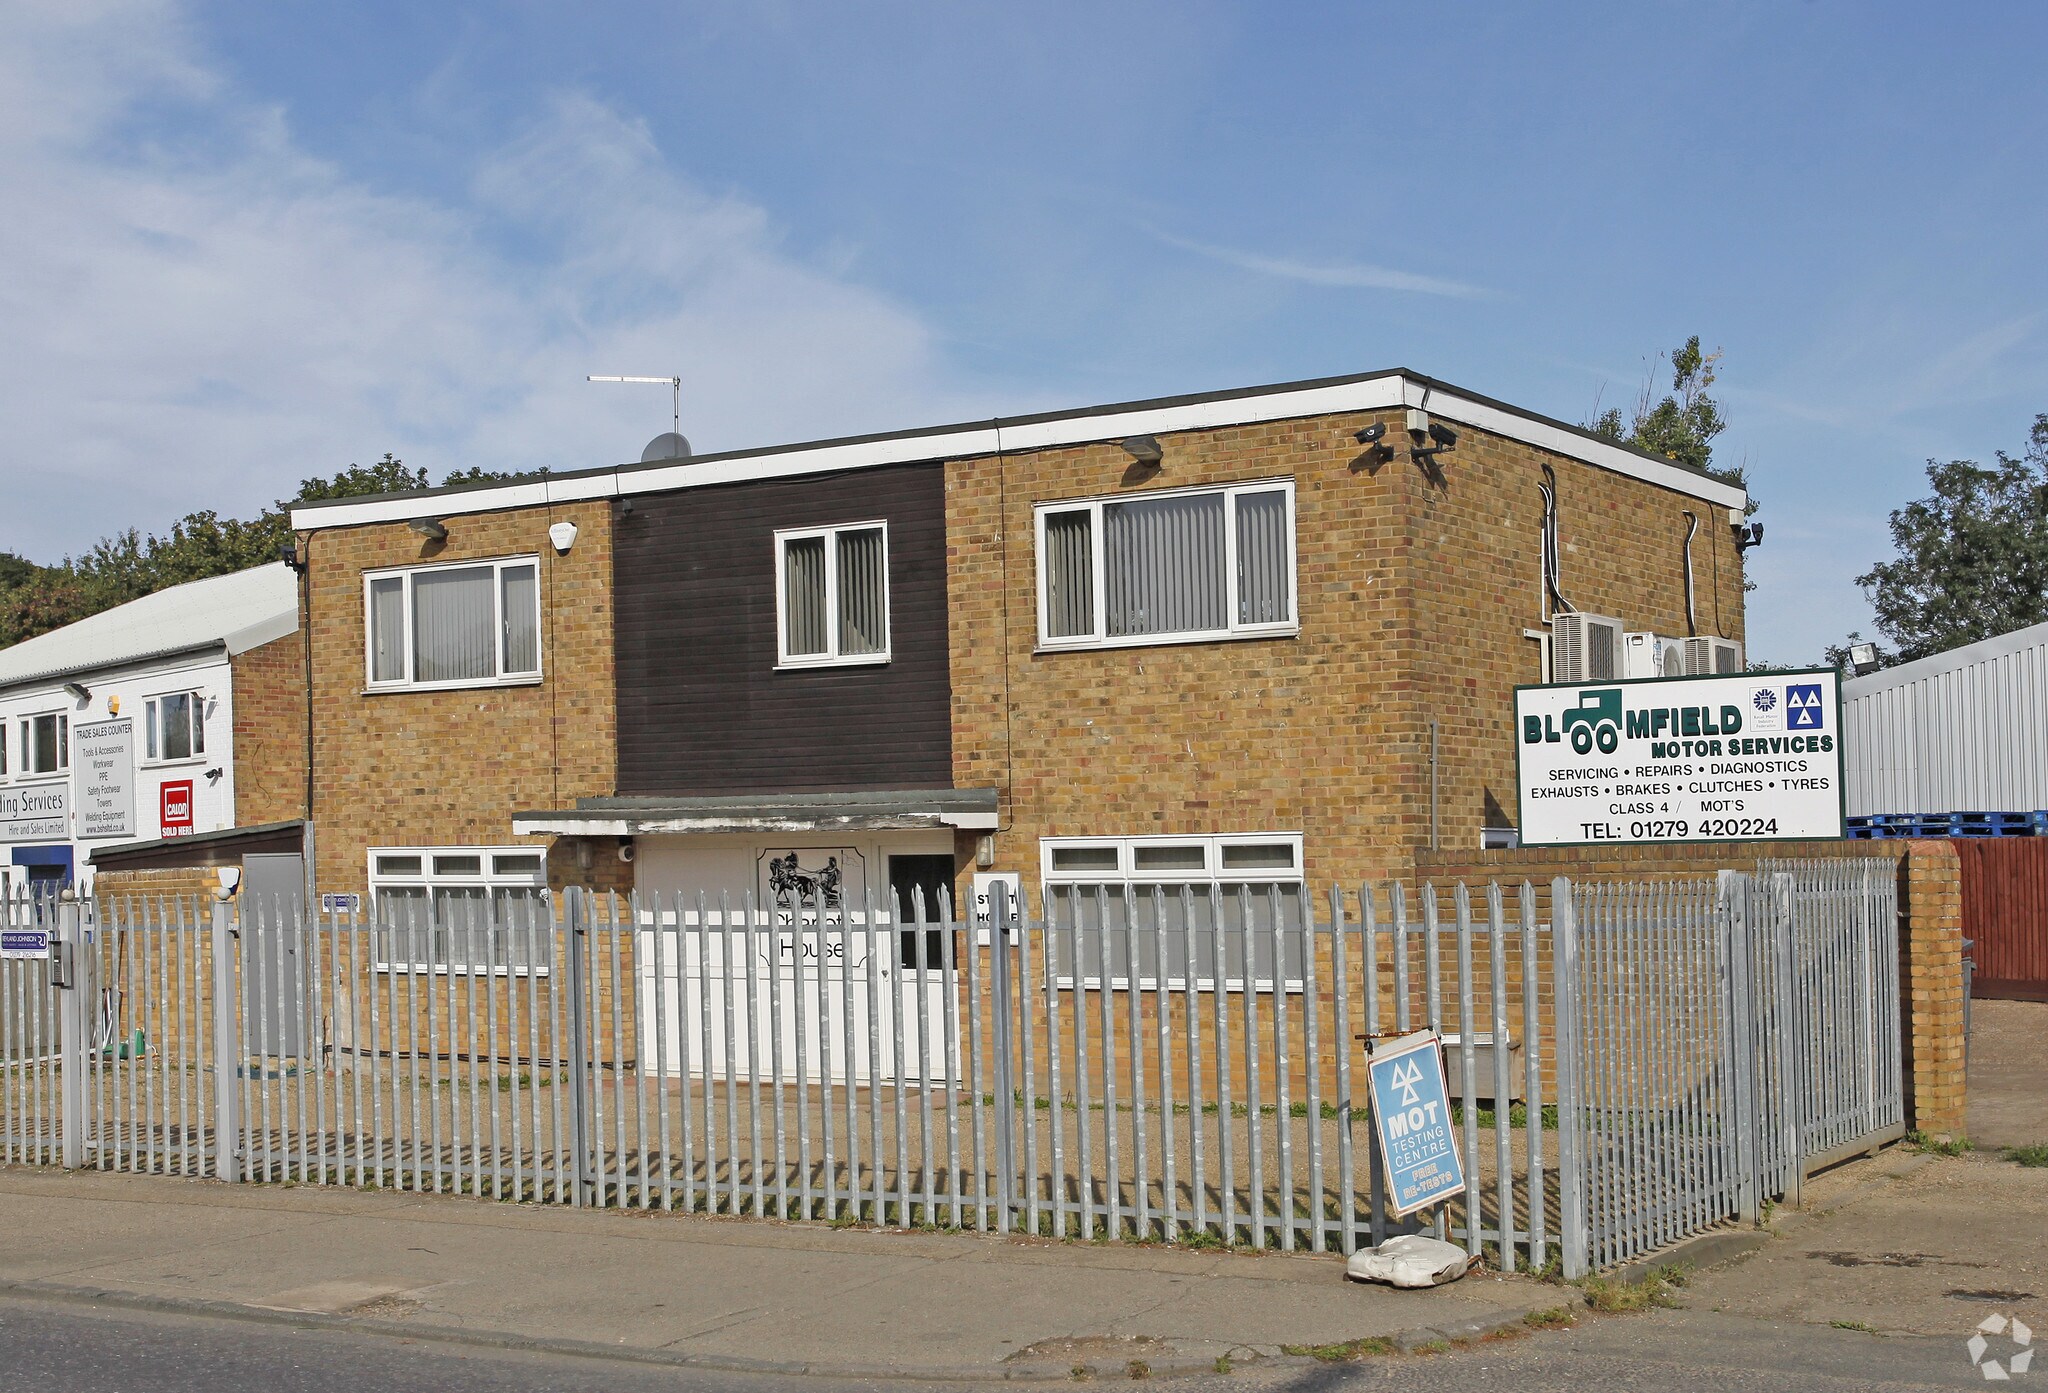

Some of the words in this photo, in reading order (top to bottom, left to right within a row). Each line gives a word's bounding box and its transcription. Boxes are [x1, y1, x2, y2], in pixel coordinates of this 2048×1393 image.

[76, 729, 91, 740] TRADE
[92, 727, 107, 738] SALES
[108, 723, 132, 735] COUNTER
[1523, 705, 1742, 755] BLOOMFIELD
[83, 748, 94, 757] Tools
[99, 745, 124, 755] Accessories
[1651, 740, 1722, 759] MOTOR
[1728, 735, 1833, 756] SERVICES
[93, 760, 114, 769] Workwear
[1549, 767, 1619, 781] SERVICING
[1635, 764, 1693, 777] REPAIRS
[1711, 760, 1808, 775] DIAGNOSTICS
[98, 771, 108, 781] PPE
[87, 786, 100, 797] Safety
[101, 785, 121, 794] Footwear
[1531, 786, 1599, 799] EXHAUSTS
[1616, 783, 1671, 796] BRAKES
[1689, 780, 1763, 793] CLUTCHES
[1781, 777, 1829, 790] TYRES
[22, 790, 63, 811] Services
[97, 798, 112, 807] Towers
[1609, 803, 1654, 815] CLASS
[1660, 802, 1669, 813] 4
[1701, 800, 1744, 812] MOT'S
[85, 812, 102, 823] Welding
[102, 810, 125, 821] Equipment
[167, 803, 187, 816] CALOR
[8, 824, 19, 835] Hire
[20, 823, 29, 834] and
[30, 822, 44, 834] Sales
[45, 821, 64, 833] Limited
[162, 826, 177, 837] SOLD
[178, 825, 193, 836] HERE
[1580, 823, 1622, 839] TEL:
[1630, 820, 1688, 838] 01279
[1699, 818, 1778, 836] 420224
[1387, 1100, 1438, 1140] MOT
[1392, 1126, 1444, 1153] TESTING
[1395, 1139, 1447, 1168] CENTRE
[1412, 1162, 1438, 1181] FREE
